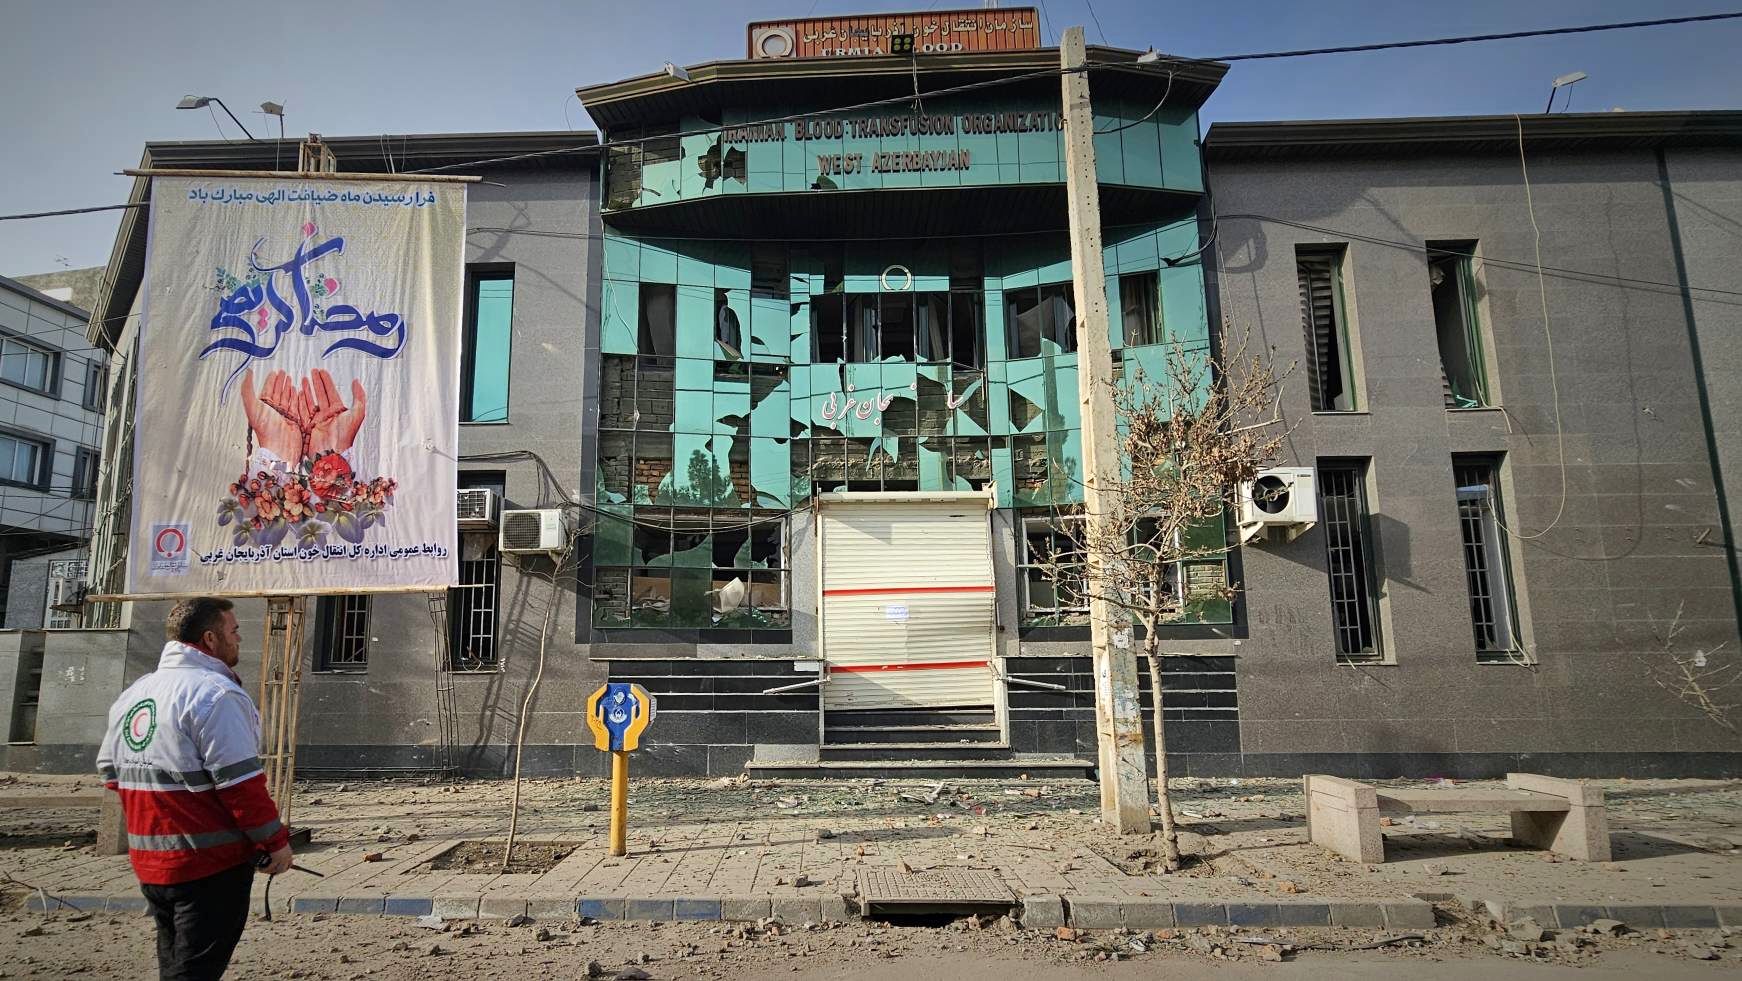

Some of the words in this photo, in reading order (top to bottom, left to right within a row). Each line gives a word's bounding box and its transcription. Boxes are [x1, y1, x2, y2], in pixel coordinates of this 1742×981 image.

[912, 19, 939, 37] خون
[941, 16, 983, 36] انتقال
[985, 15, 1033, 33] سازمان
[803, 26, 837, 45] غربی
[821, 47, 884, 56] URMIA
[914, 43, 962, 53] OOD
[723, 122, 785, 142] IRANIAN
[795, 119, 844, 141] BLOOD
[849, 114, 955, 139] TRANSFUSION
[961, 111, 1065, 134] ORGANIZATIO
[817, 152, 862, 175] WEST
[872, 149, 970, 173] AZERBAYJAN
[189, 188, 208, 204] باد
[255, 189, 285, 205] الهی
[287, 188, 338, 204] ضیافت
[340, 190, 361, 202] ماه
[822, 384, 856, 430] غربی
[200, 549, 224, 563] غربی
[226, 545, 272, 561] آذربایجان
[273, 547, 297, 560] استان
[299, 545, 320, 560] خون
[322, 545, 347, 558] انتقال
[349, 544, 362, 558] کل
[364, 544, 387, 558] اداره
[389, 545, 419, 557] عمومی
[422, 542, 447, 557] روابط
